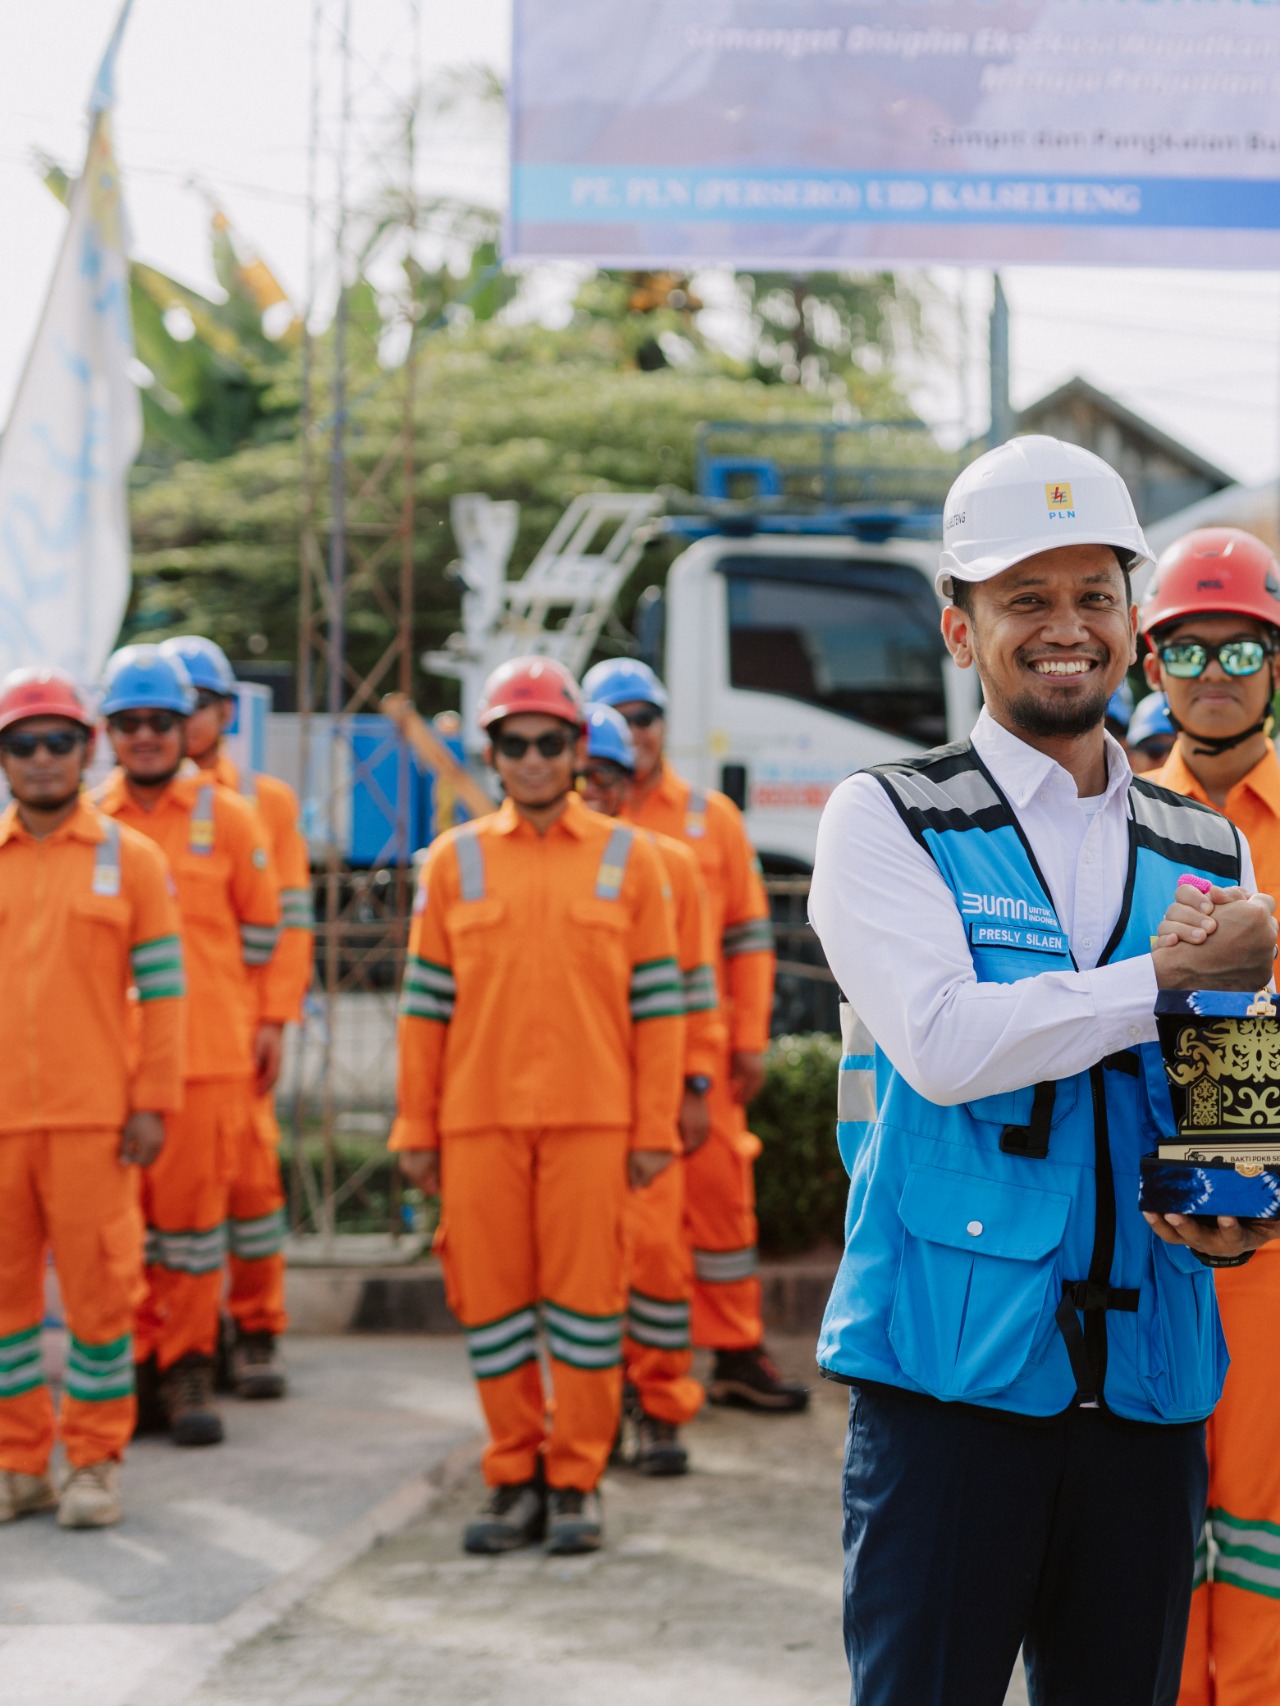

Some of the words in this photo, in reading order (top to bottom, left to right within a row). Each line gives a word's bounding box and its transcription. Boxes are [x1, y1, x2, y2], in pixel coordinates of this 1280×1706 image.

[626, 178, 690, 210] PLN
[1049, 510, 1076, 520] PLN
[962, 892, 1028, 920] BUMN
[979, 928, 1020, 943] PRESLY
[1026, 933, 1062, 949] SILAEN
